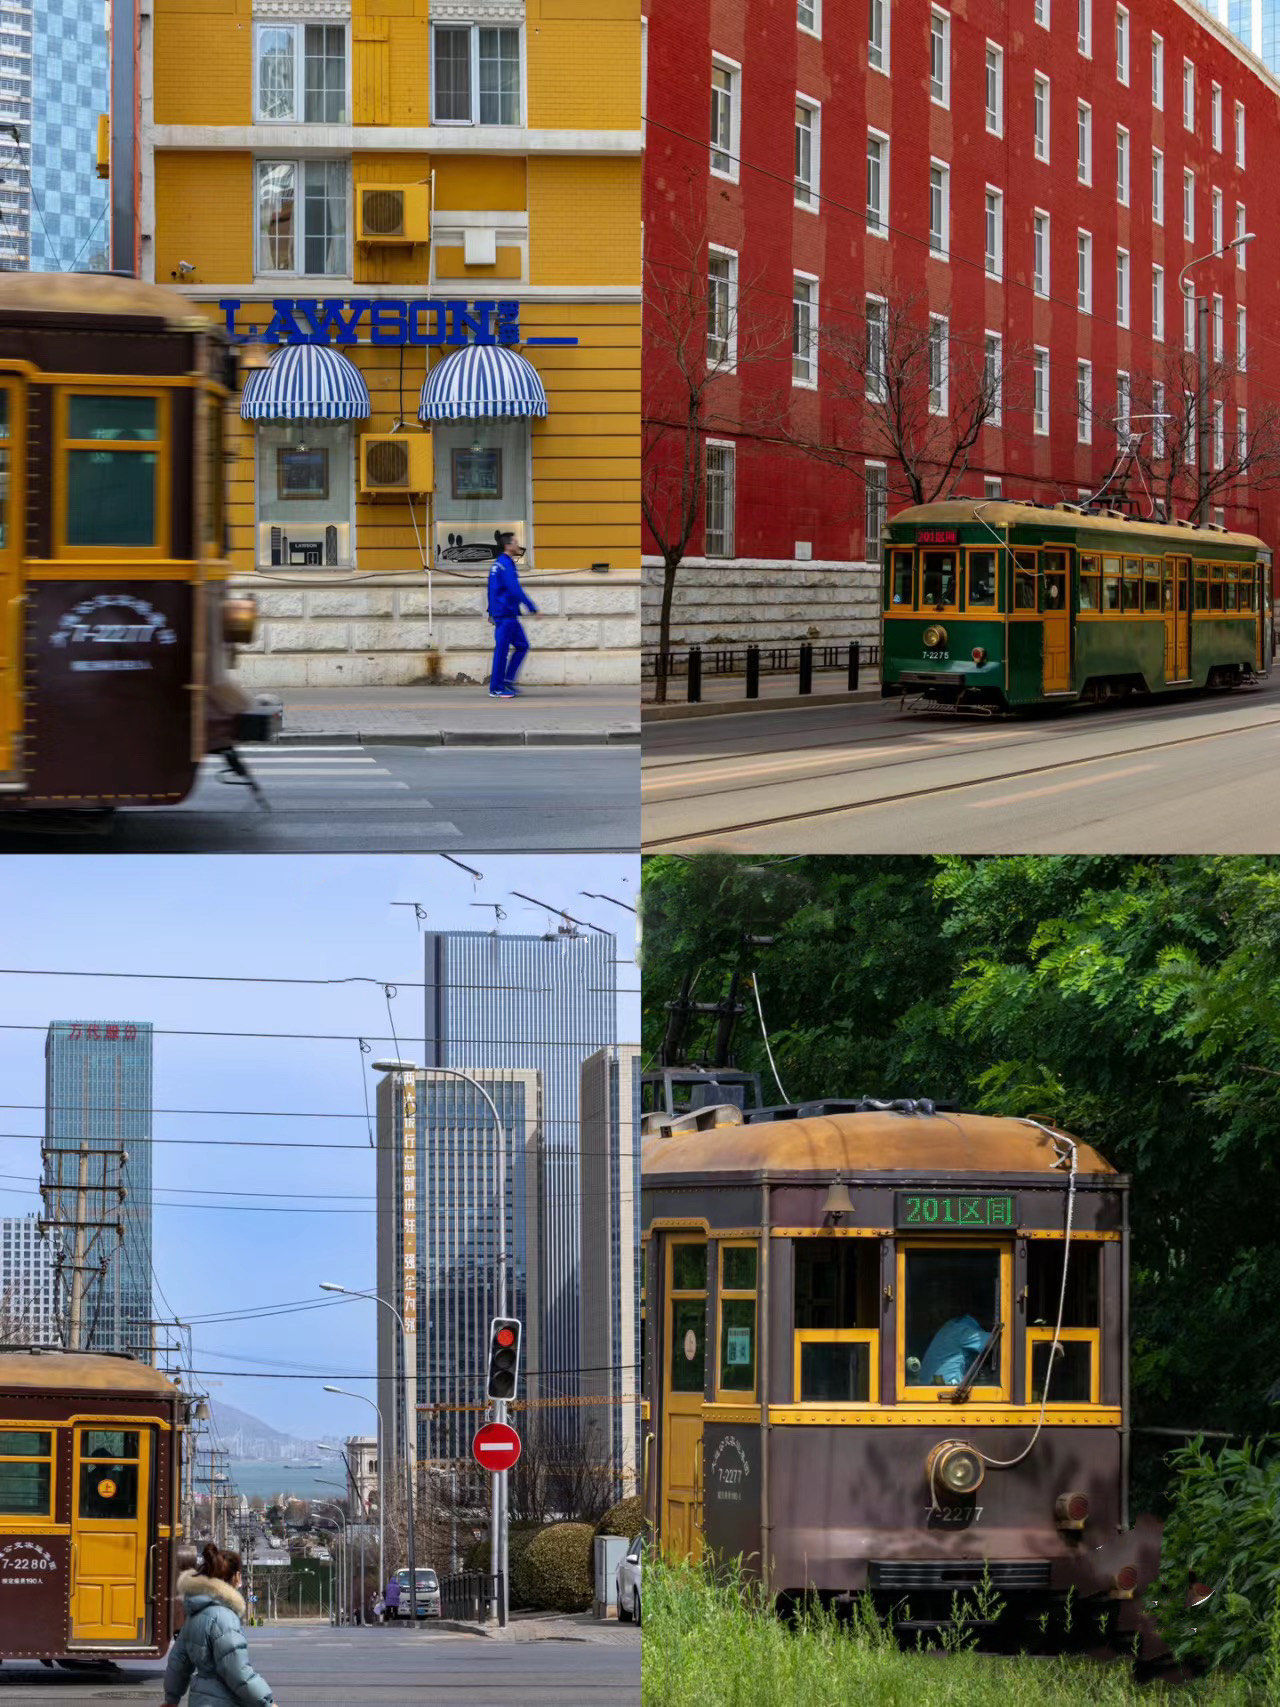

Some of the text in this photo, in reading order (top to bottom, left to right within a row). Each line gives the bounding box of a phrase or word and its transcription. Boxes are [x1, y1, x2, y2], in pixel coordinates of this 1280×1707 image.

[219, 299, 497, 345] LAWSON
[922, 651, 950, 660] 7-2275
[906, 1197, 1013, 1226] 201区间
[718, 1468, 743, 1483] 7-2277
[924, 1506, 984, 1521] 7-2277
[2, 1558, 47, 1570] 7-2280
